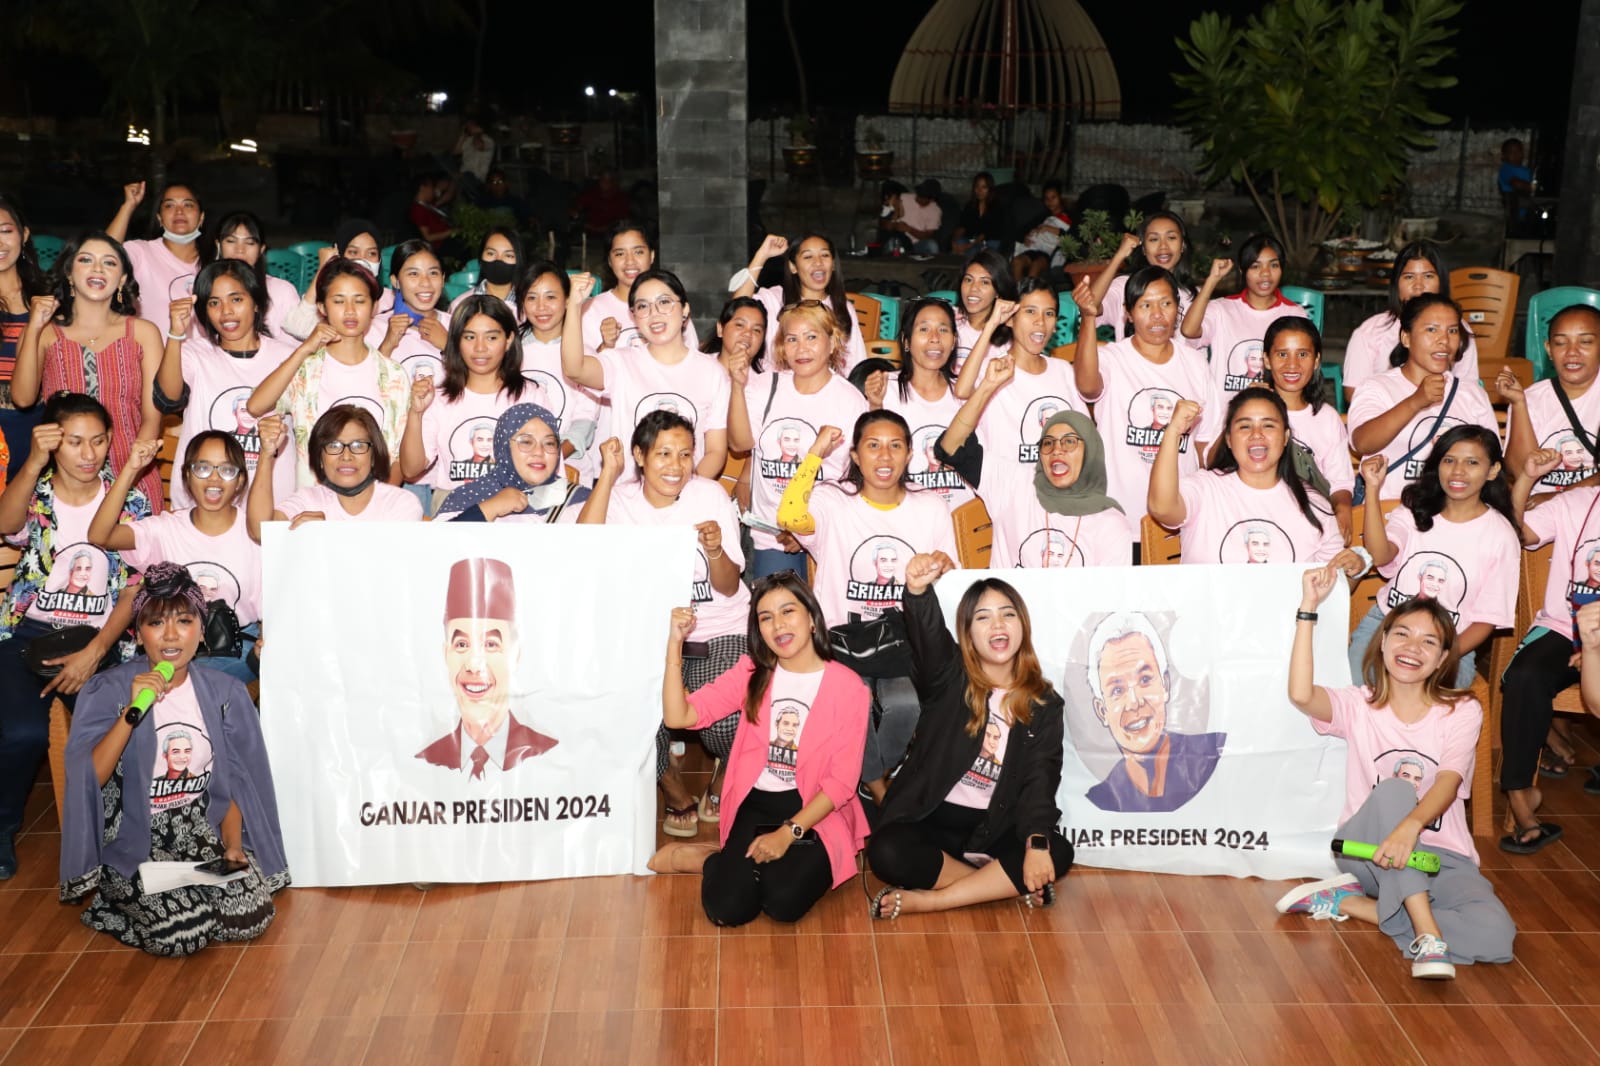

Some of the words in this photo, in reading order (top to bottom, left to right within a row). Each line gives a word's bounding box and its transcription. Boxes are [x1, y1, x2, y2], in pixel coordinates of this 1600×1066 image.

[450, 462, 495, 479] SRIKA
[847, 581, 904, 600] SRIKAN
[360, 801, 447, 826] GANJAR
[452, 797, 549, 825] PRESIDEN
[555, 794, 611, 820] 2024
[1110, 828, 1207, 847] PRESIDEN
[1214, 827, 1269, 851] 2024
